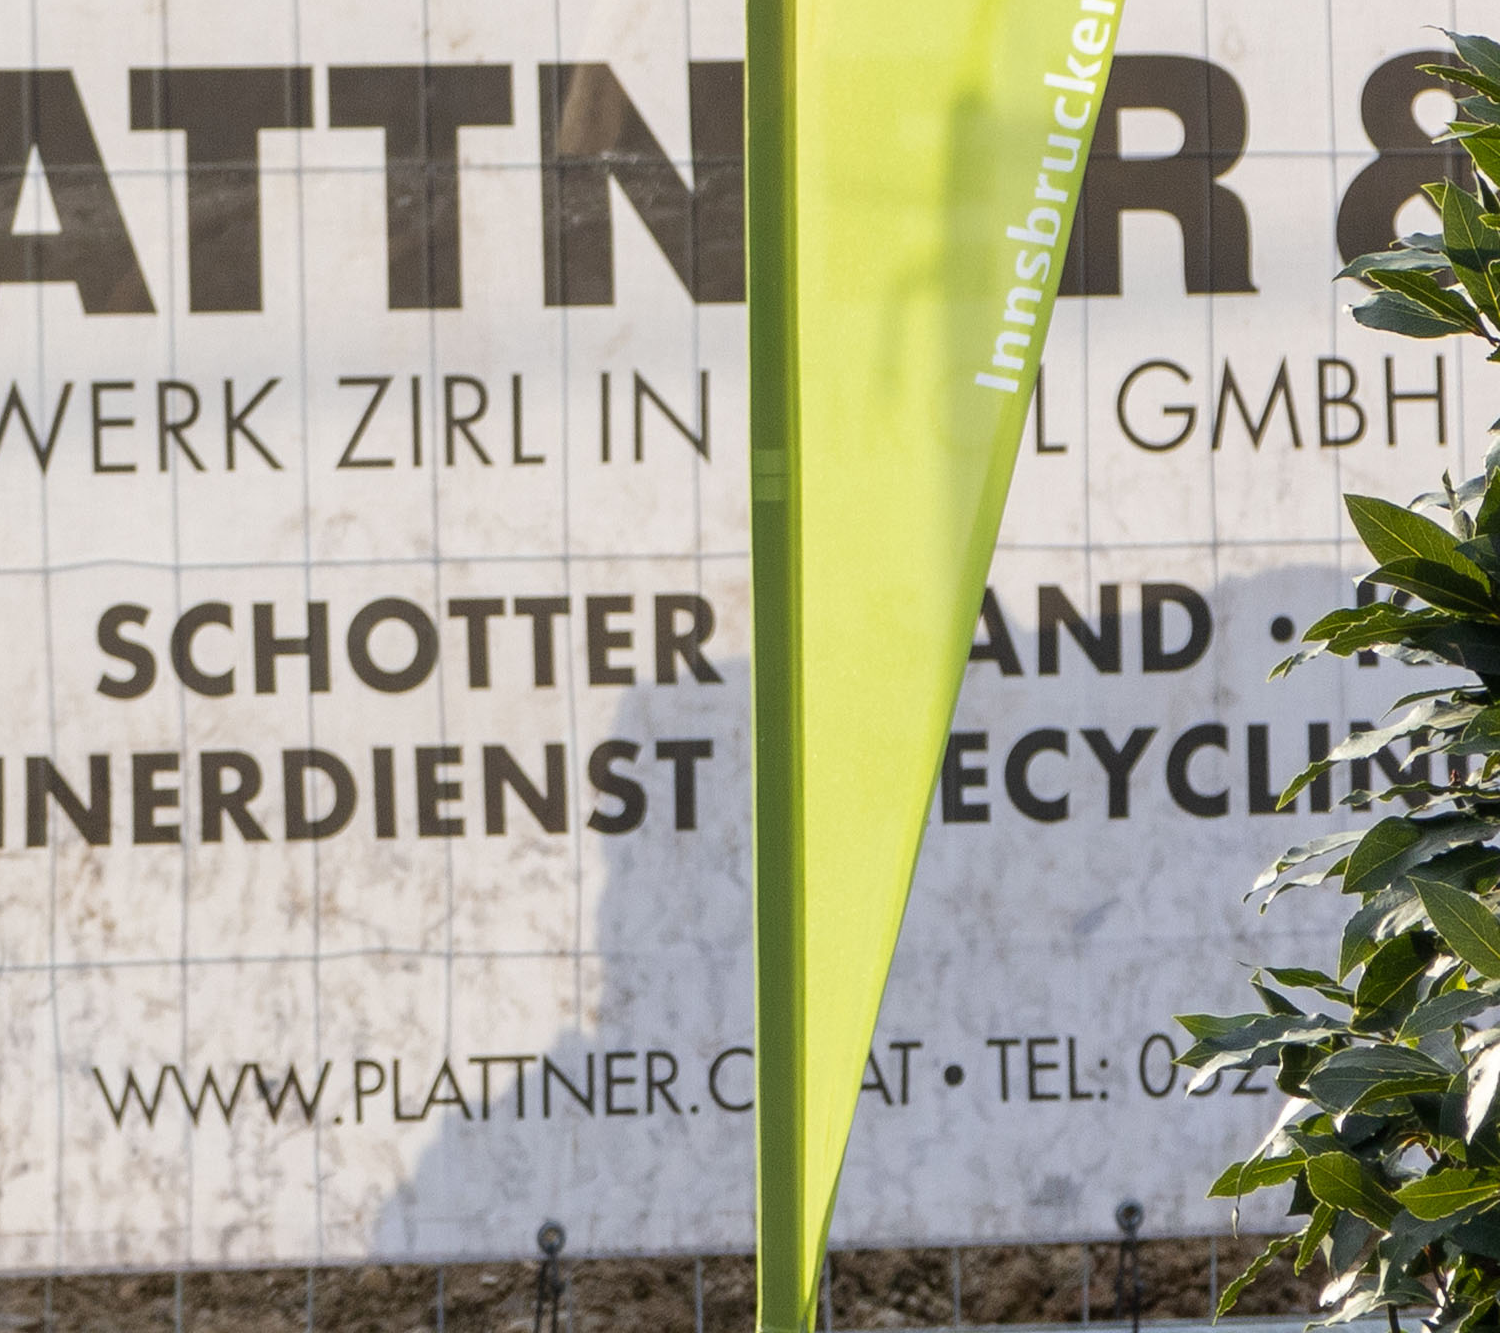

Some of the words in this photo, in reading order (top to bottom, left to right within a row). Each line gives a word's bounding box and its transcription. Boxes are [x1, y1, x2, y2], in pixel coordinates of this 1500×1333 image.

[336, 373, 546, 469] ZIRL
[601, 369, 710, 463] IN
[1116, 354, 1447, 454] GMBH
[96, 593, 725, 700] SCHOTTER
[966, 581, 1214, 678] AND
[927, 721, 1475, 824] ECYCLIN
[986, 1036, 1110, 1103] TEL:
